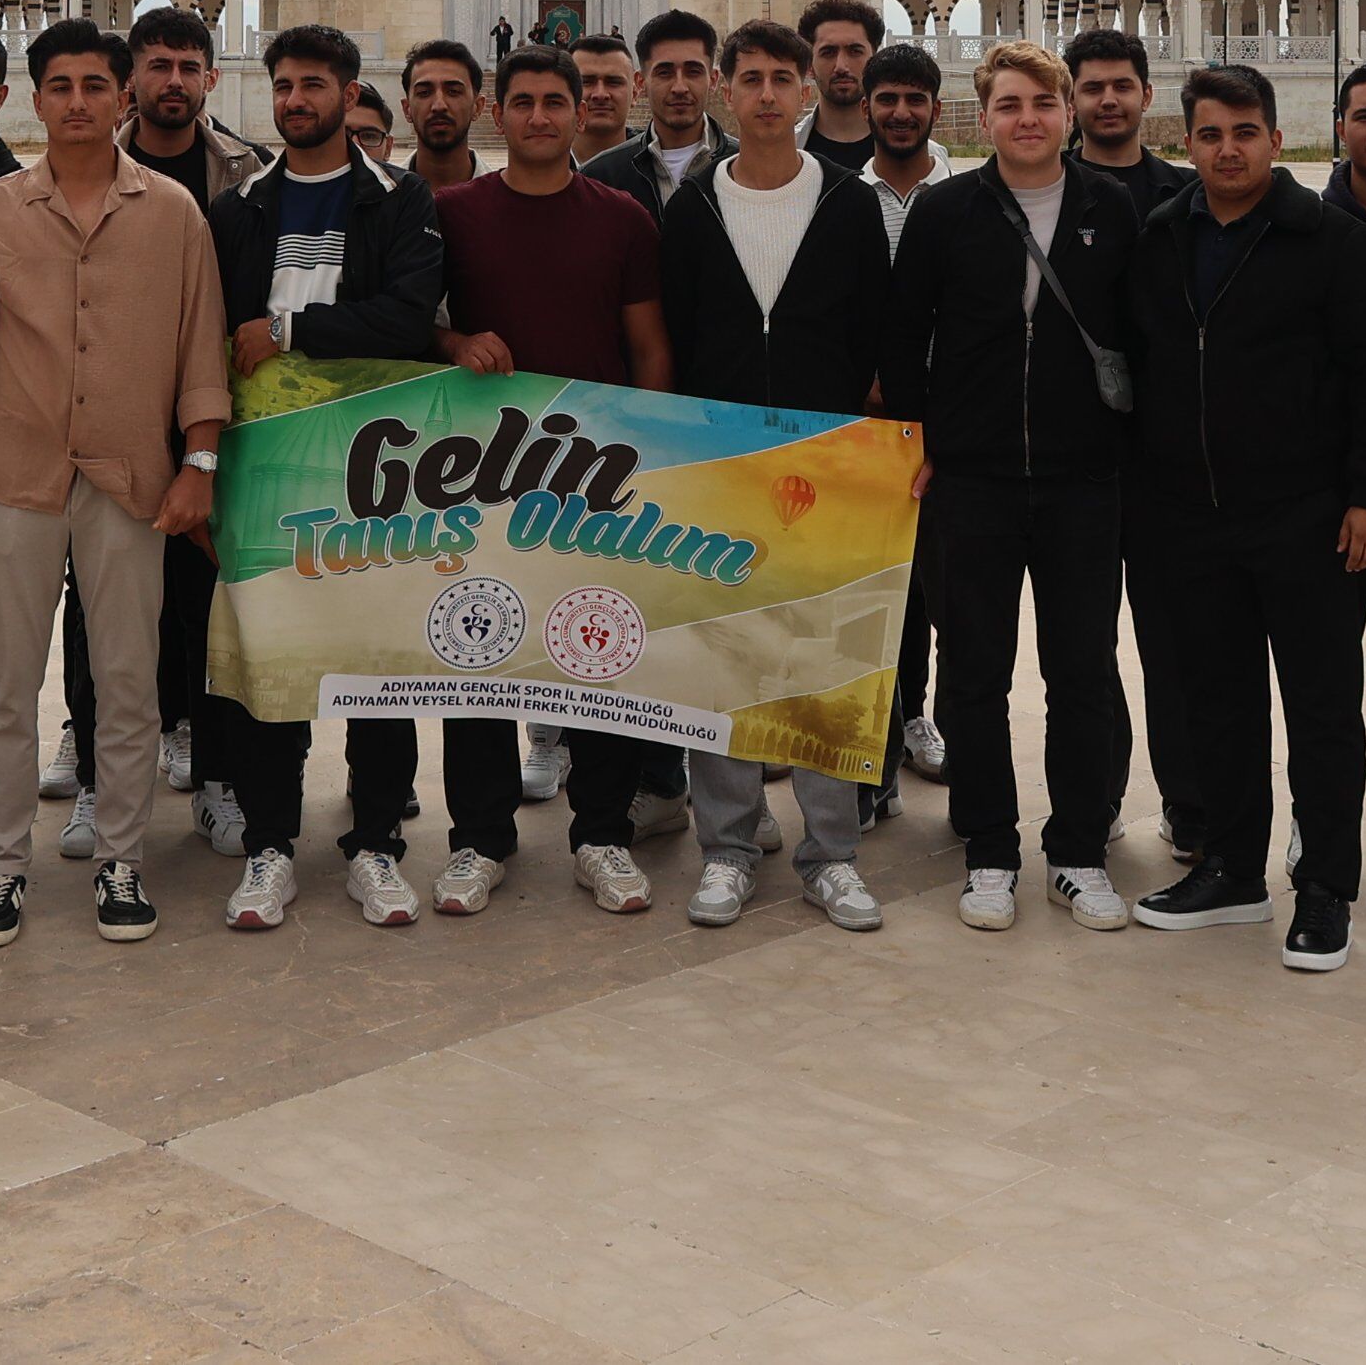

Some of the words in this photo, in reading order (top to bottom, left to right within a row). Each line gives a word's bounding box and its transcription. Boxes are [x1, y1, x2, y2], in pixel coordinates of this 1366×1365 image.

[346, 406, 639, 520] Gelin
[279, 505, 484, 579] Tanış
[505, 489, 757, 585] Olalım
[332, 695, 409, 706] ADIYAMAN
[412, 695, 463, 706] VEYSEL
[466, 695, 520, 708] KARANİ
[523, 699, 569, 715] ERKEK
[571, 705, 621, 722] YURDU
[624, 714, 717, 741] MÜDÜRLÜĞÜ
[380, 681, 458, 693] ADIYAMAN
[460, 681, 520, 695] GENÇLİK
[524, 685, 562, 700] SPOR
[565, 688, 577, 702] İL
[580, 692, 673, 718] MÜDÜRLÜĞÜ
